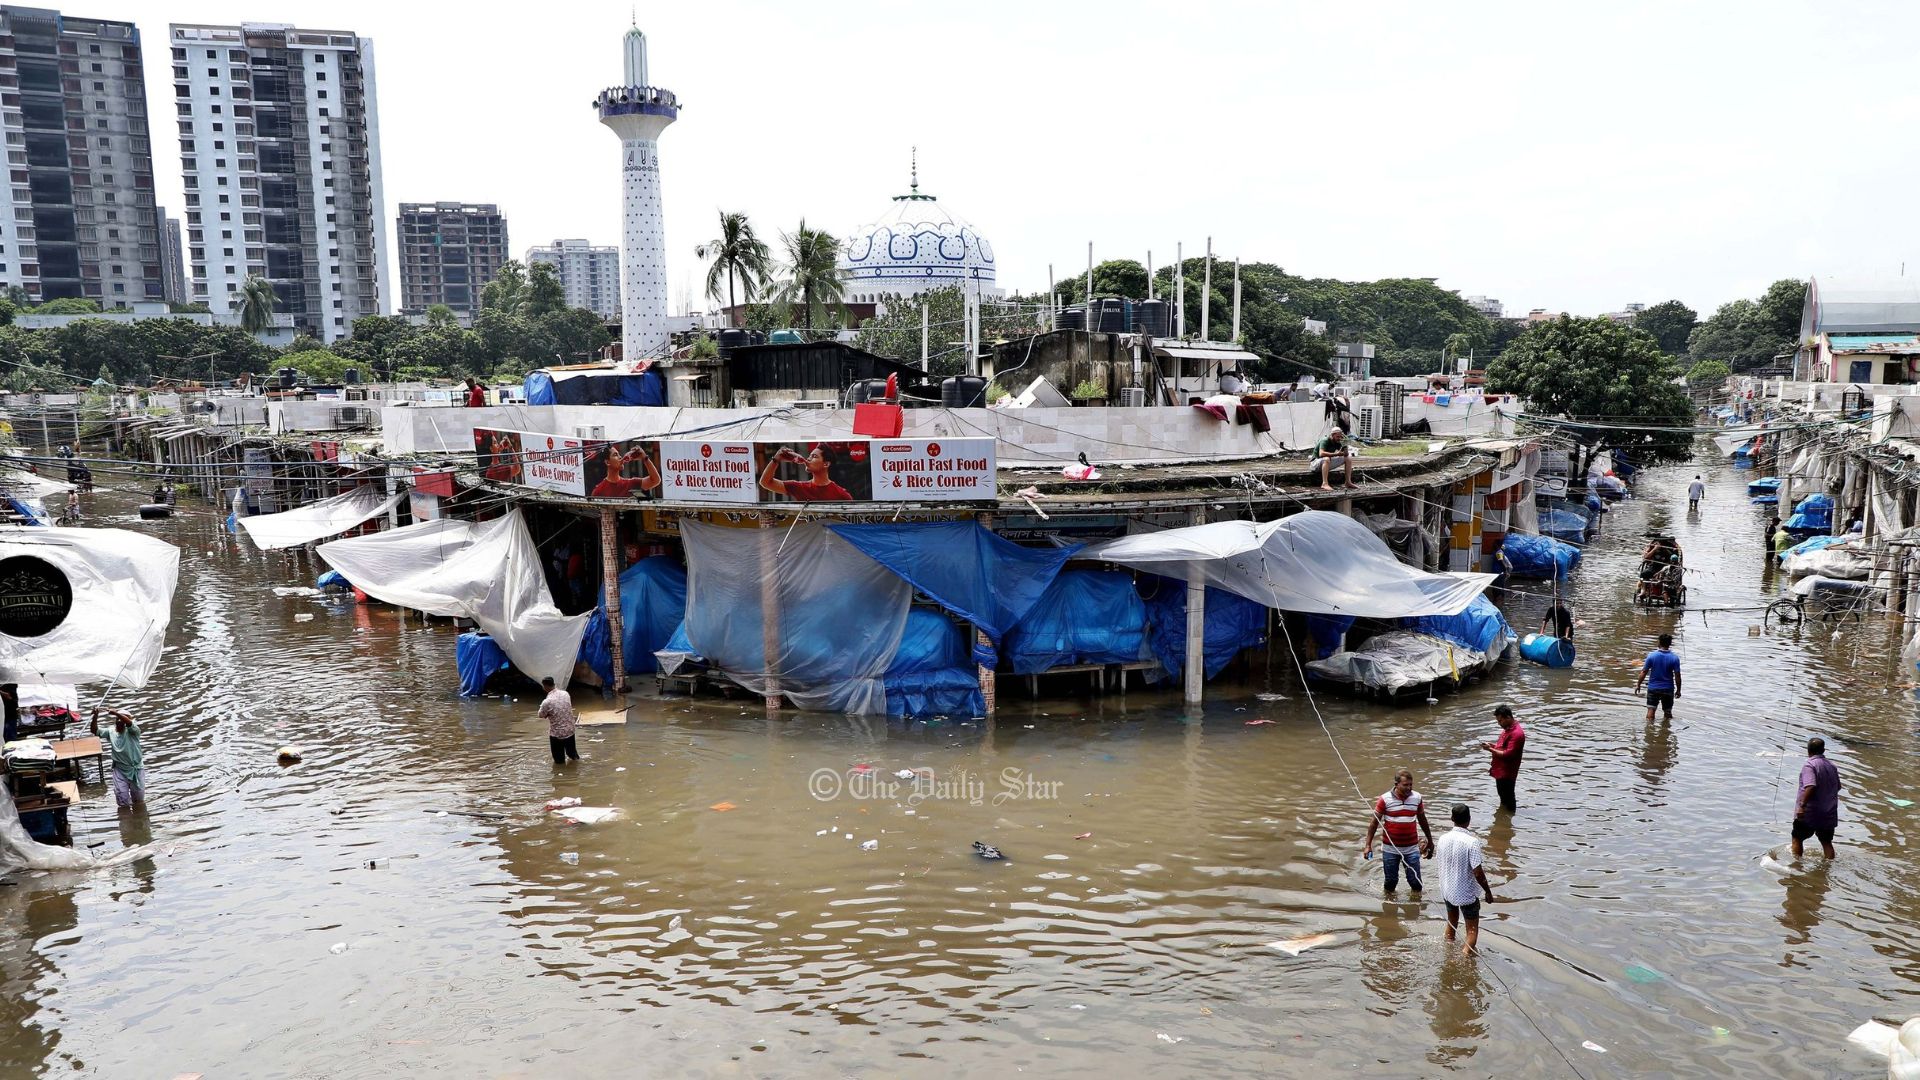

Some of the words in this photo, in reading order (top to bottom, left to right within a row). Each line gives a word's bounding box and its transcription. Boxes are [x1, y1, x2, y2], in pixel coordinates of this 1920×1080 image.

[563, 453, 579, 467] Food
[666, 458, 700, 473] Capital
[702, 459, 722, 472] Fast
[725, 460, 750, 473] Food
[882, 458, 925, 473] Capital
[928, 458, 953, 471] Fast
[957, 458, 987, 471] Food
[531, 464, 538, 477] &
[538, 465, 553, 479] Rice
[554, 467, 575, 483] Corner
[675, 474, 683, 487] &
[686, 474, 707, 487] Rice
[709, 475, 743, 488] Corner
[892, 476, 903, 488] &
[906, 475, 934, 488] Rice
[937, 474, 978, 488] Corner
